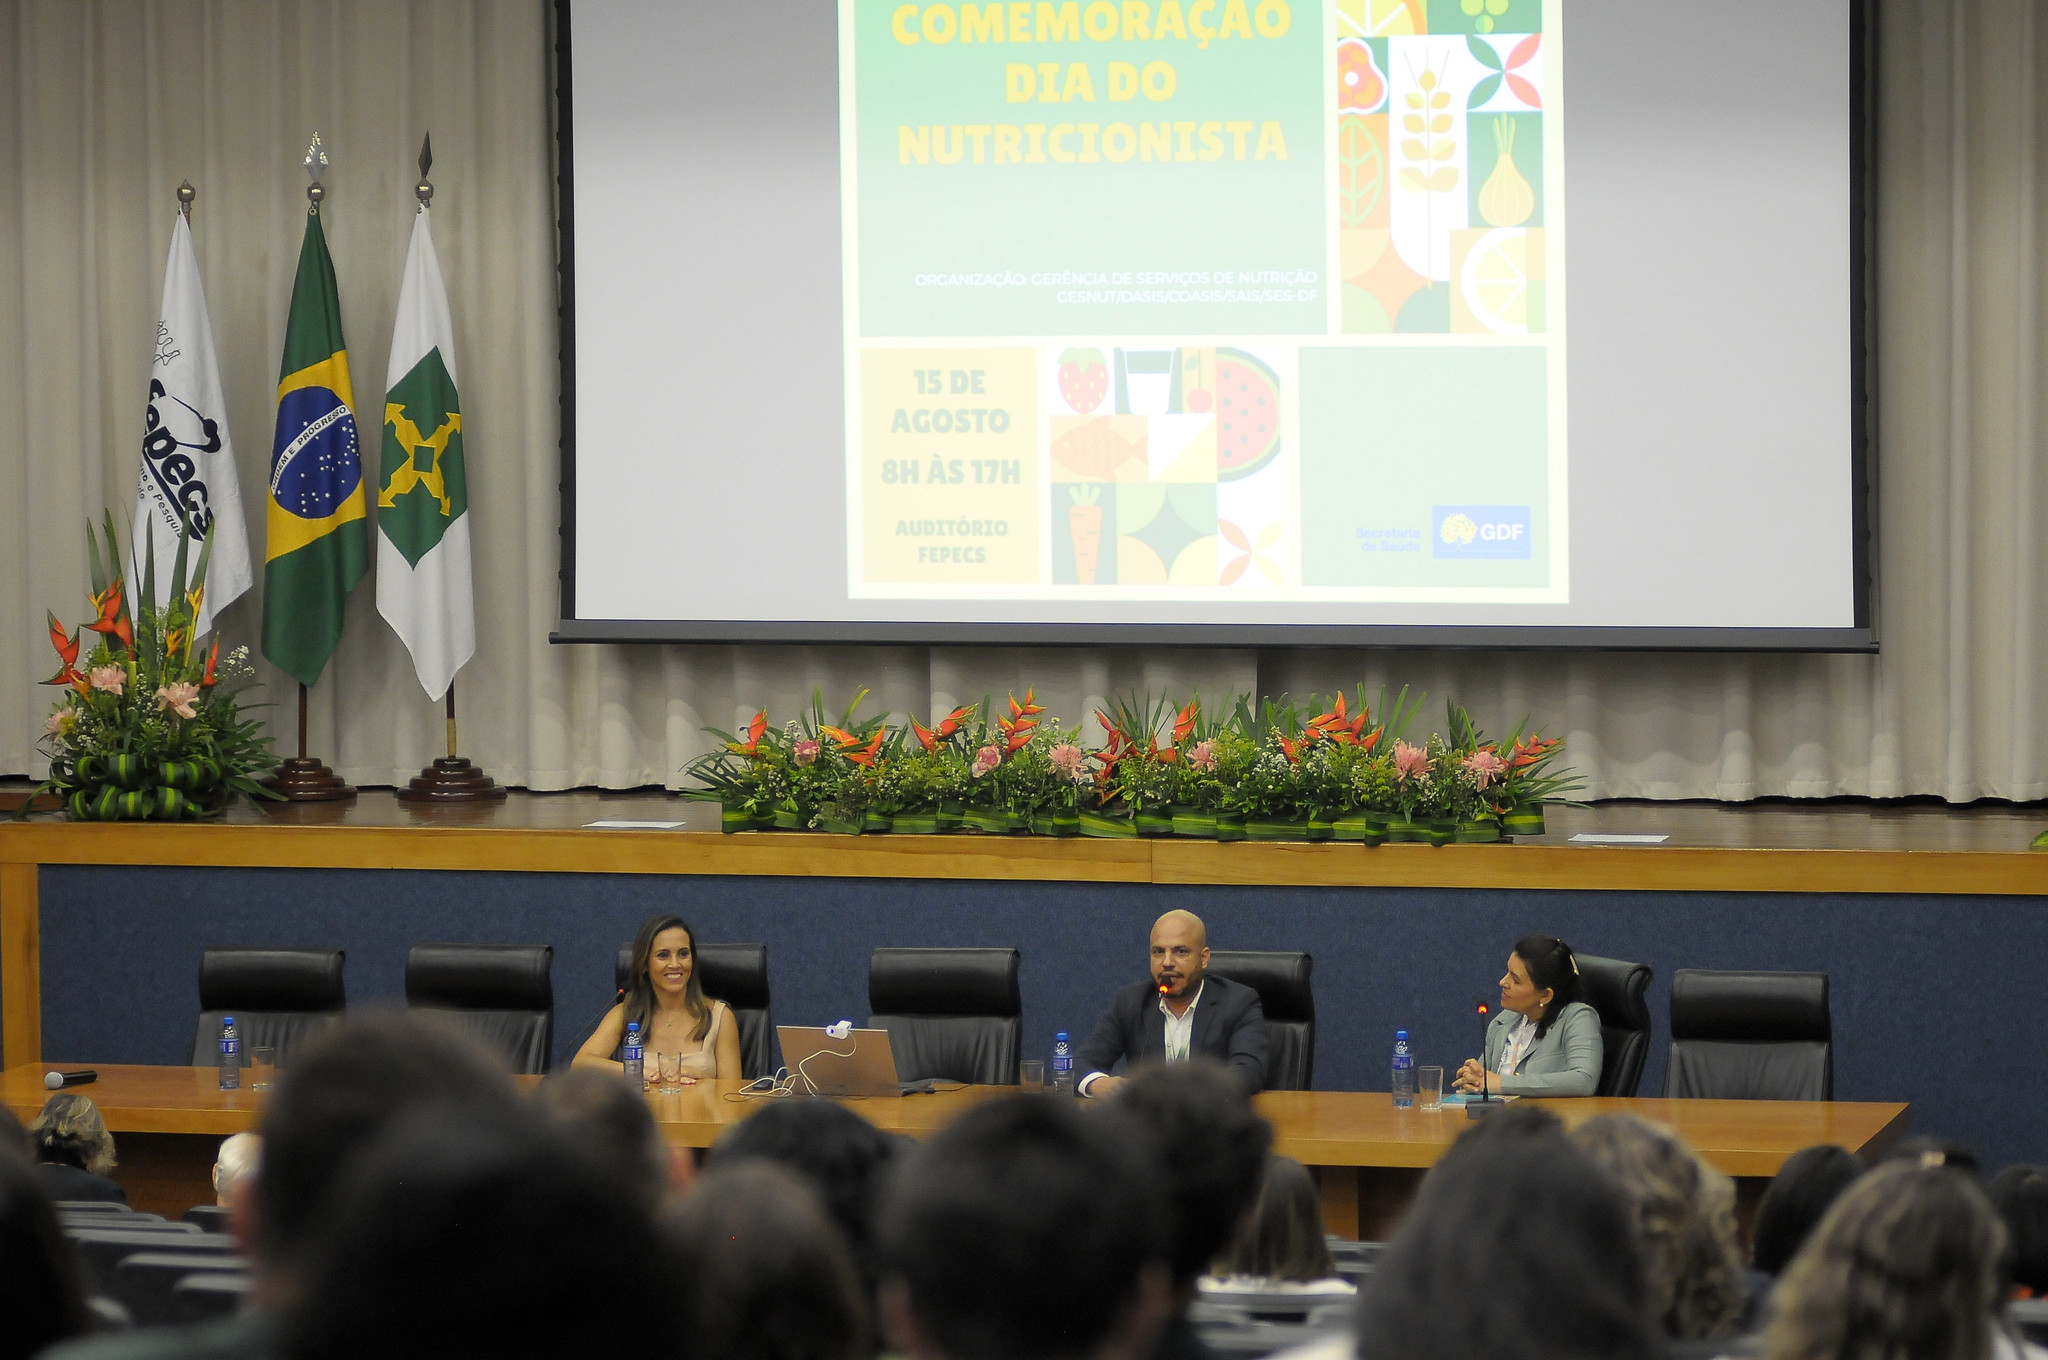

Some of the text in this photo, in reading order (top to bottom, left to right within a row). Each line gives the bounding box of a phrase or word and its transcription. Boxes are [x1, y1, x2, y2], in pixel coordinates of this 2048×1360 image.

[1005, 60, 1177, 104] DIA DO
[898, 120, 1289, 166] NUTRICIONISTA
[1031, 269, 1108, 286] GERÊNCIA
[1112, 271, 1133, 286] DE
[1136, 271, 1211, 288] SERVIÇOS
[1215, 271, 1235, 285] DE
[1238, 269, 1318, 287] NUTRIÇÃO
[913, 369, 986, 395] 15 DE
[890, 408, 1010, 434] AGOSTO
[881, 453, 1021, 485] 8H ÀS 17H
[895, 515, 1009, 537] AUDITÓRIO
[1355, 527, 1421, 539] Secretaria
[1480, 523, 1524, 541] GDF
[918, 546, 986, 564] FEPECS
[1361, 540, 1421, 553] de Saúde
